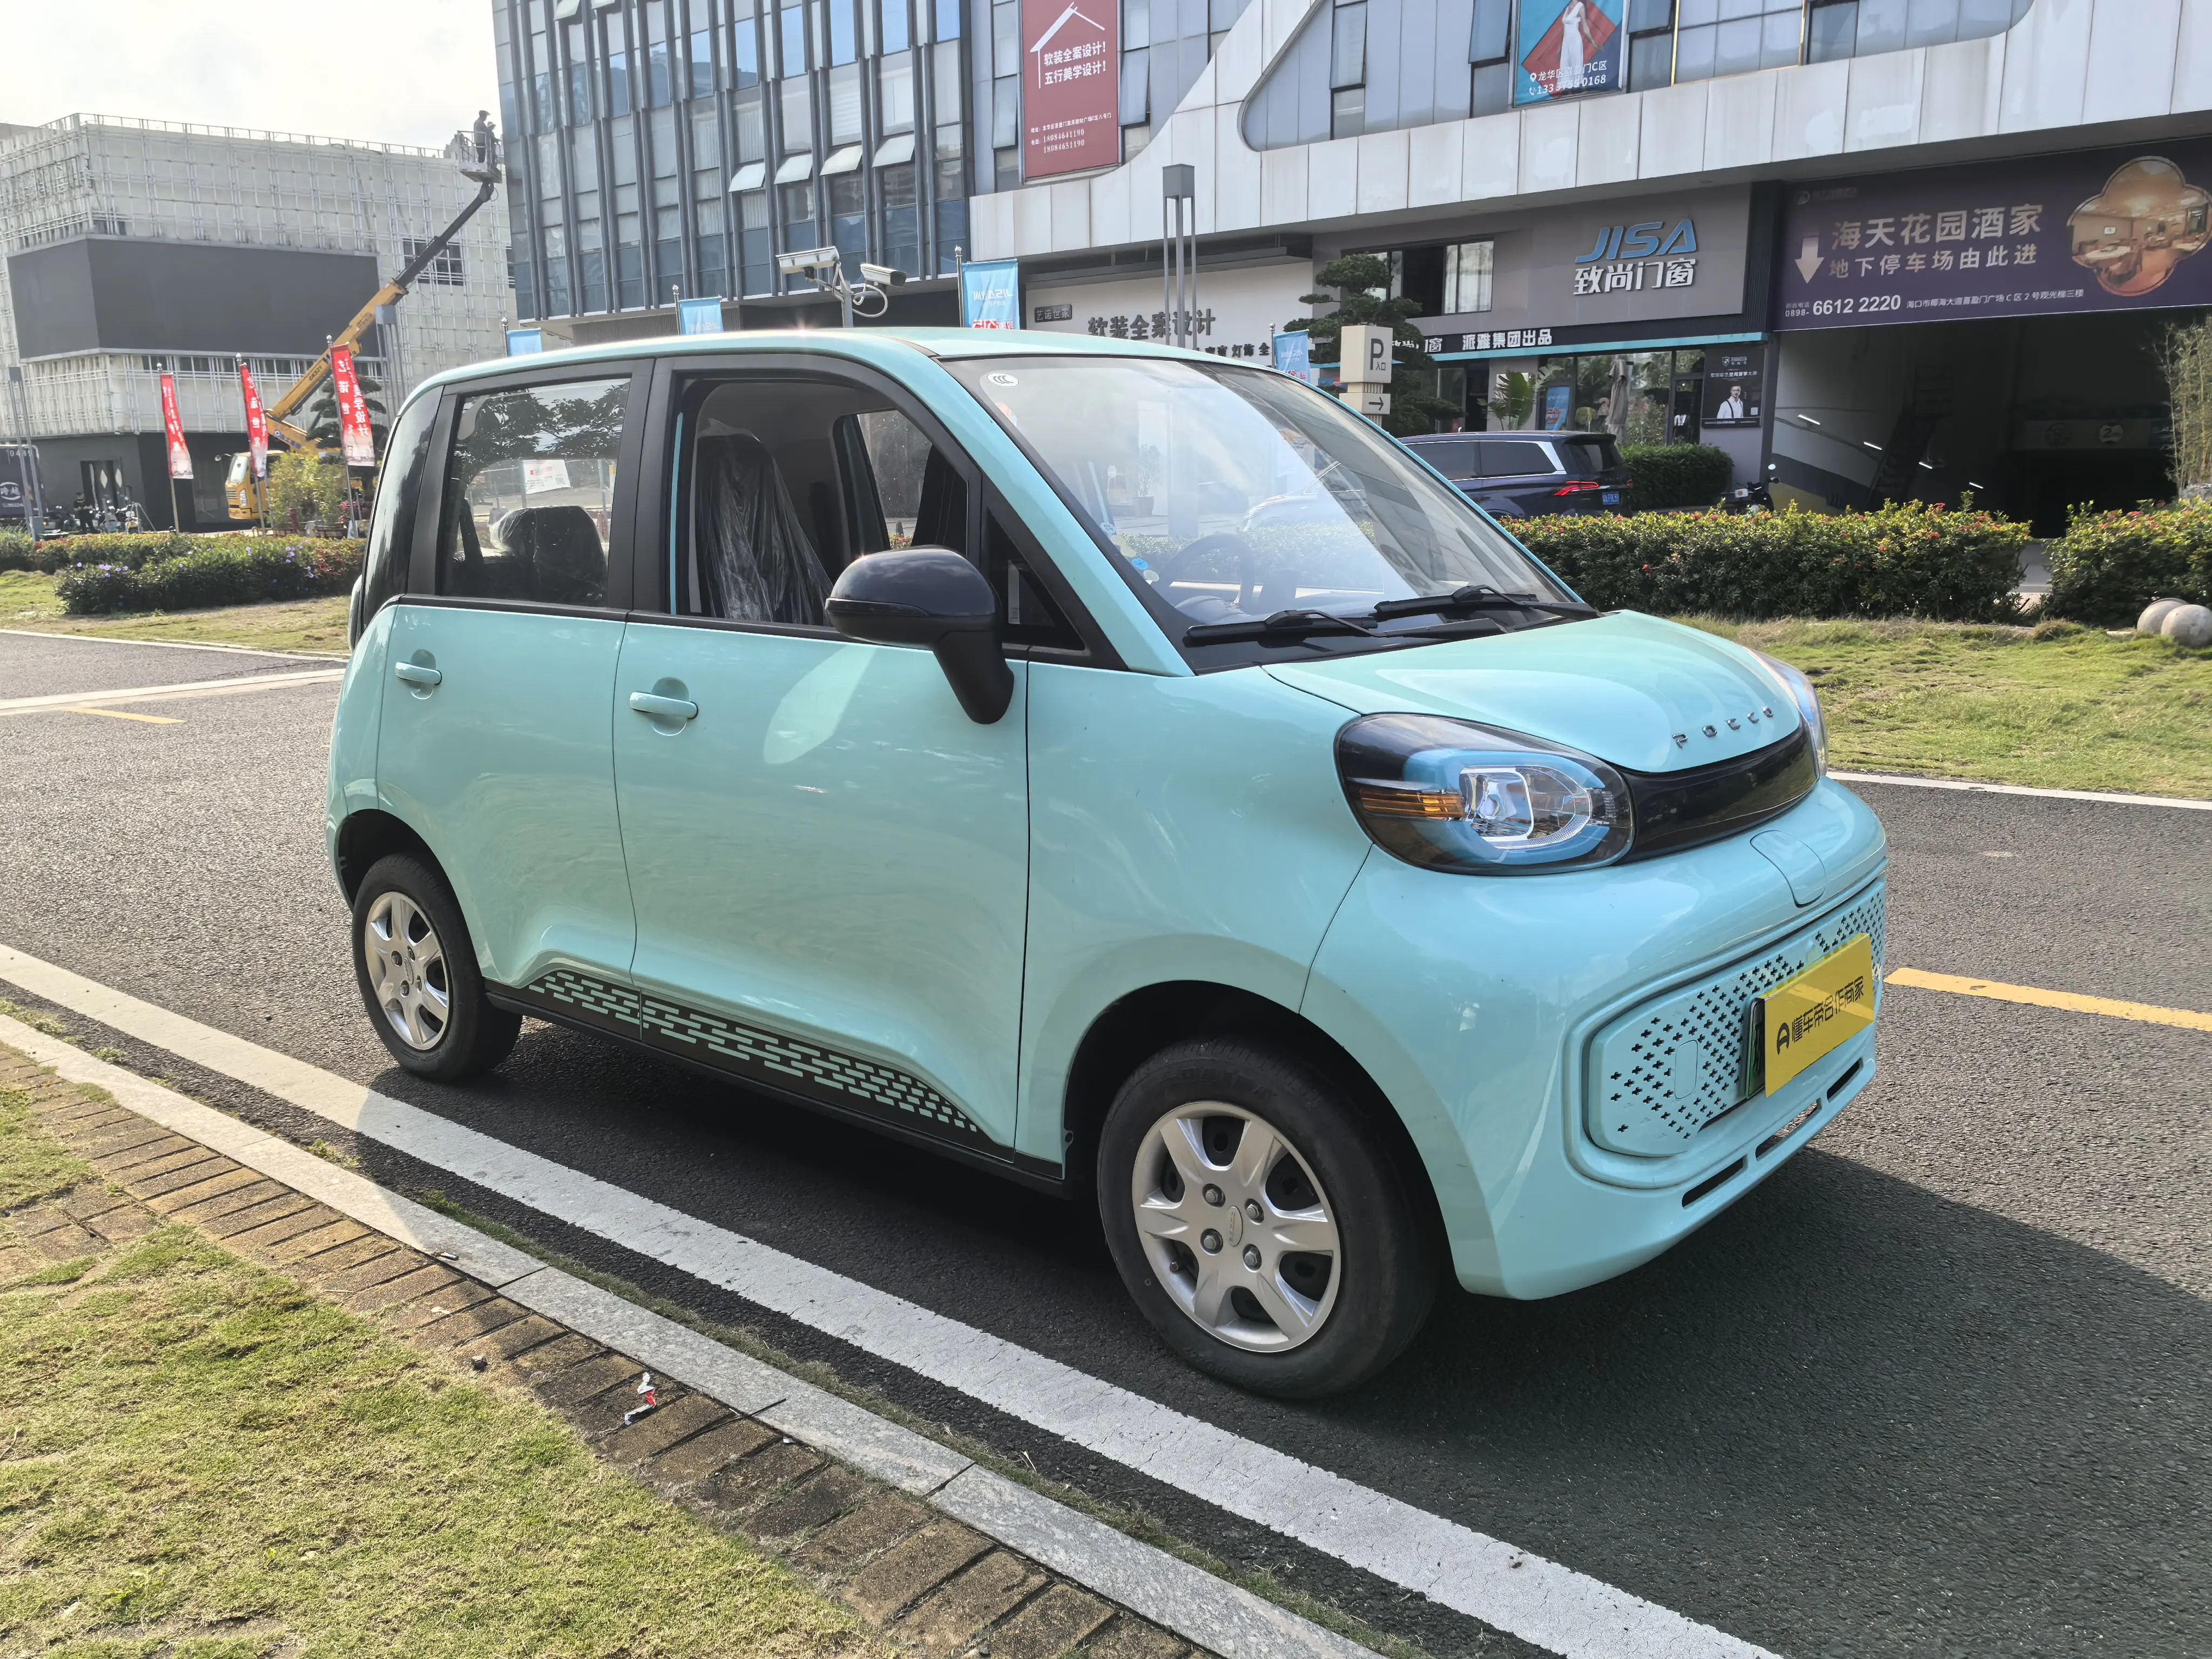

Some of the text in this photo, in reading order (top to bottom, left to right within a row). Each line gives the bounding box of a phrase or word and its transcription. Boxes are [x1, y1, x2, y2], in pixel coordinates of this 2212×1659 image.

[1537, 84, 1554, 95] 133
[1582, 75, 1607, 86] 0168
[1575, 218, 1697, 264] JISA
[1832, 204, 2043, 251] 海天花园酒家
[1573, 258, 1696, 295] 致尚门窗
[1829, 243, 2038, 278] 地下停车场由此进
[1036, 307, 1070, 321] 艺诺世家
[1813, 298, 1854, 315] 6612
[1858, 295, 1901, 312] 2220
[1370, 338, 1384, 370] P
[1462, 328, 1552, 350] 派雅集团出品
[1375, 362, 1386, 371] 入口
[1672, 706, 1774, 750] POCCO
[1791, 975, 1864, 1043] 懂车帝合作商家
